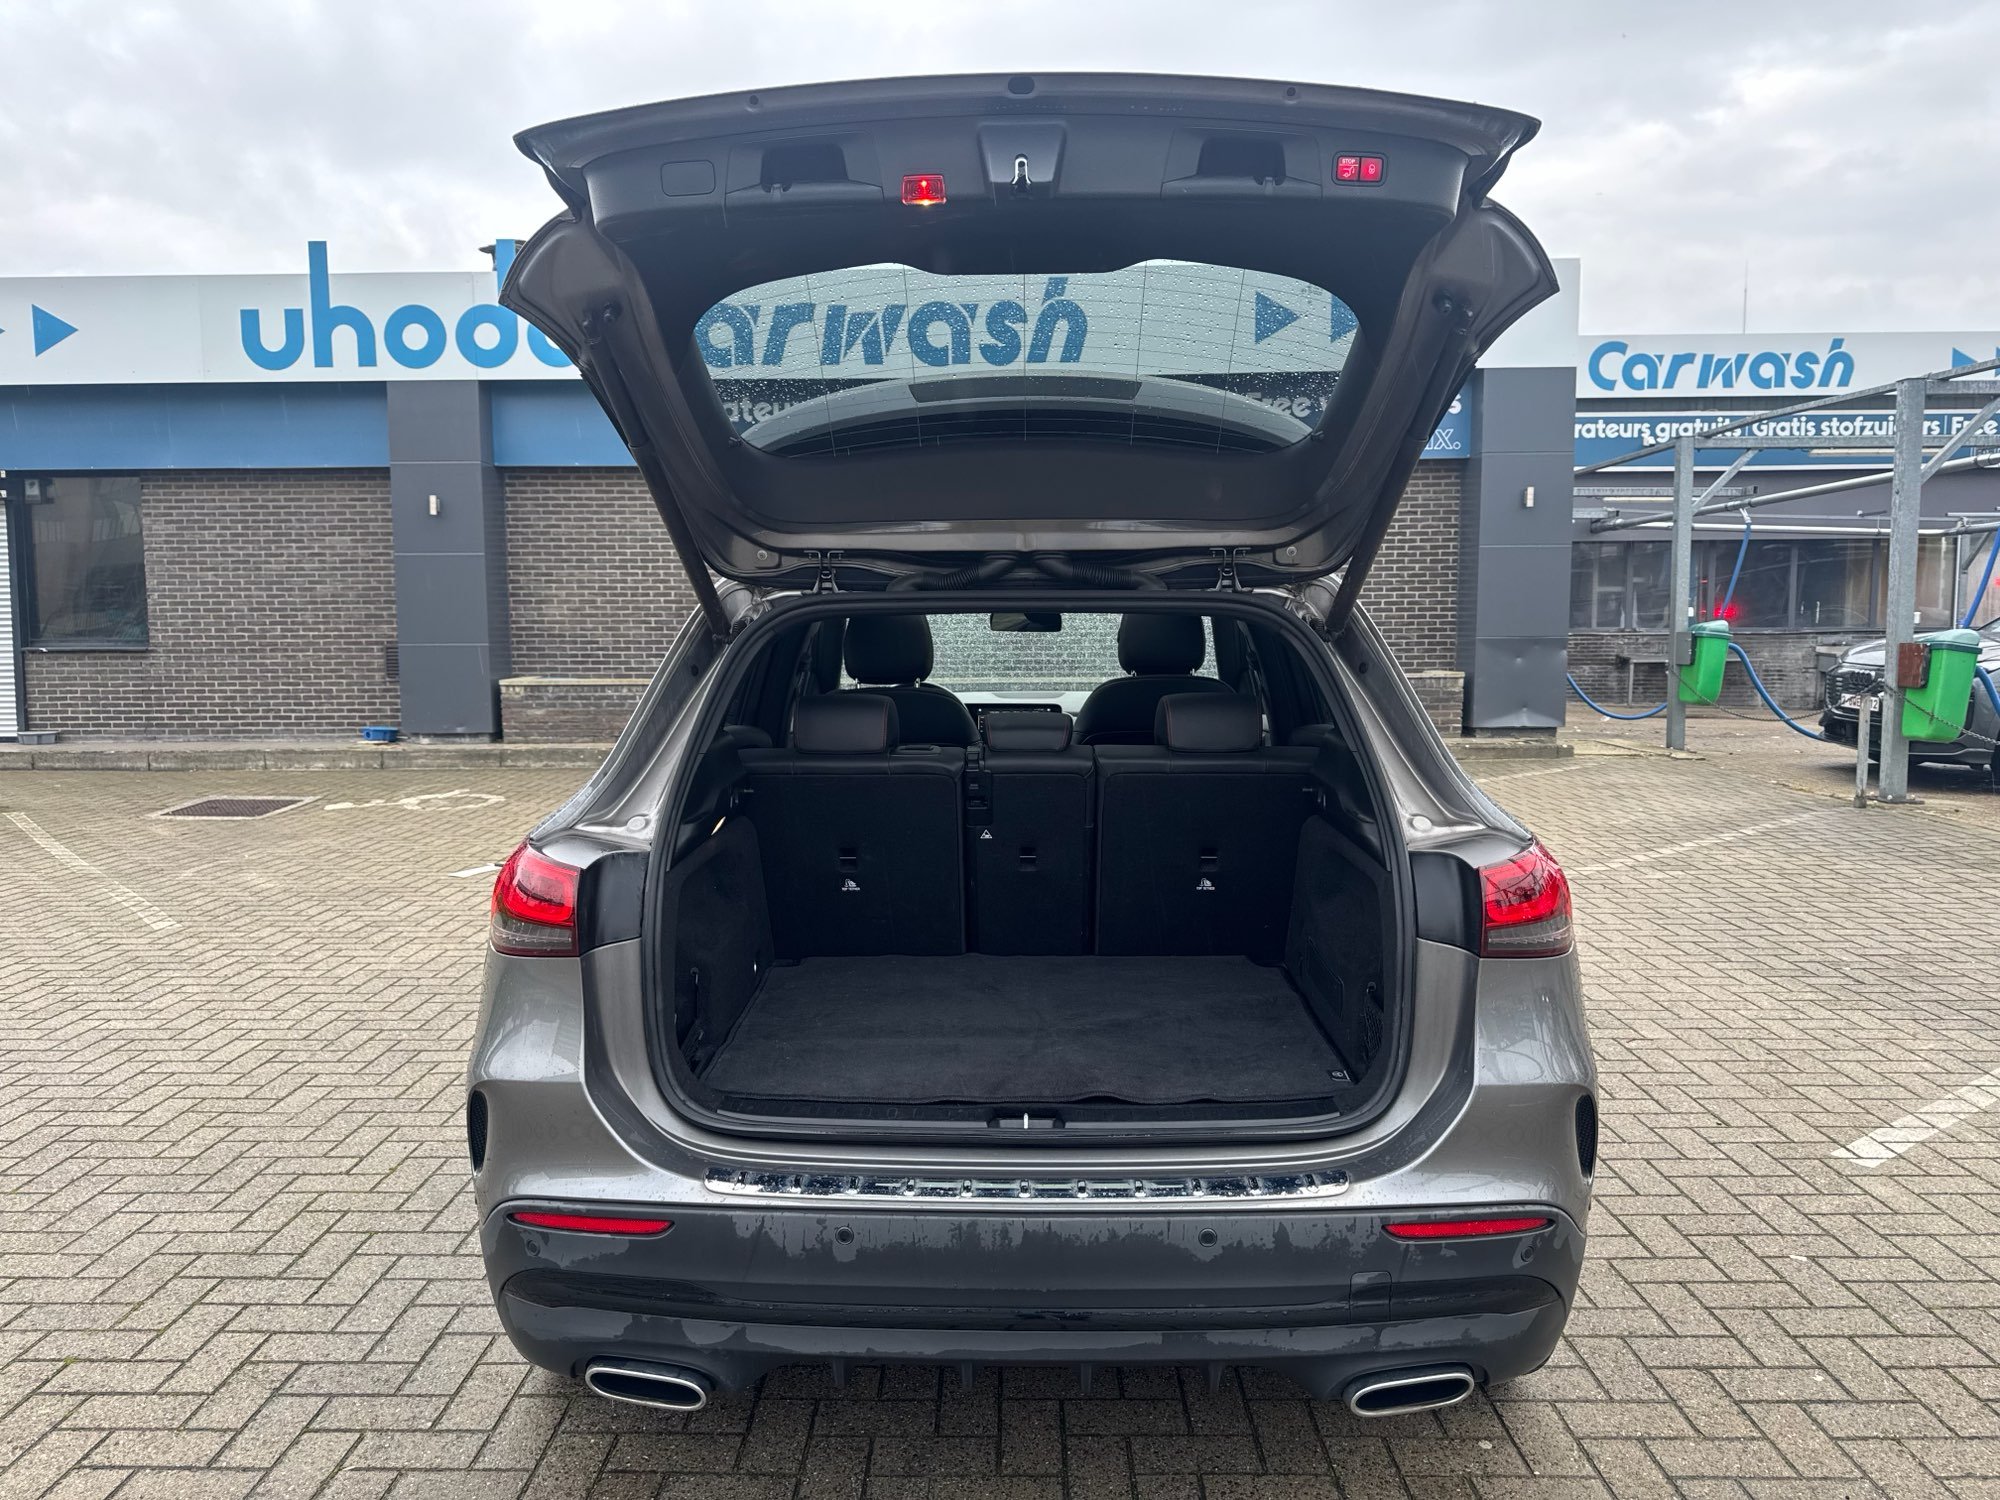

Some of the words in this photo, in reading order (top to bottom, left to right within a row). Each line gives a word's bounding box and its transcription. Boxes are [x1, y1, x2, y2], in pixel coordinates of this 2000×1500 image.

[693, 277, 1088, 367] arwash
[1588, 338, 1855, 391] Carwash
[1574, 420, 1651, 438] rateurs
[1752, 416, 1816, 437] Gratis
